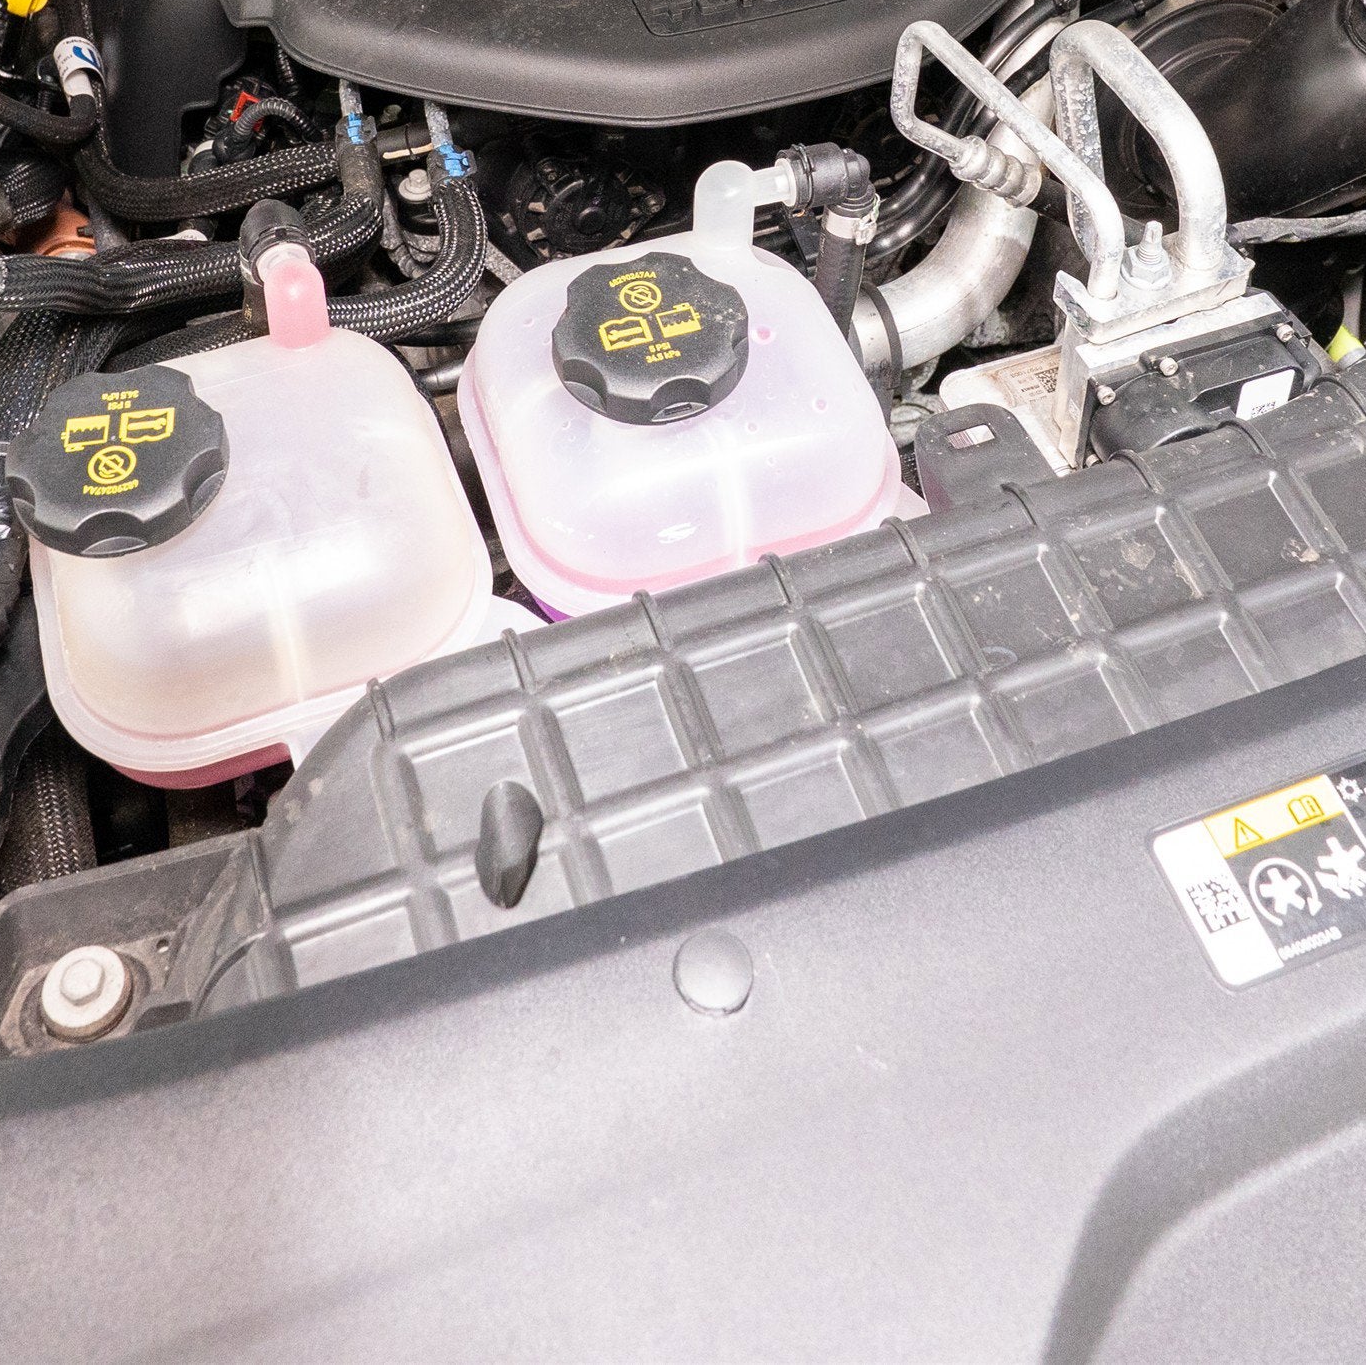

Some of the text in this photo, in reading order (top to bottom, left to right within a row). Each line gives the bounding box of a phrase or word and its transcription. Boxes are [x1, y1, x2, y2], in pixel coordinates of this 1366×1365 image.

[655, 342, 671, 351] PSI
[663, 350, 681, 360] kPa
[101, 392, 120, 402] kPa
[107, 401, 124, 411] PSI
